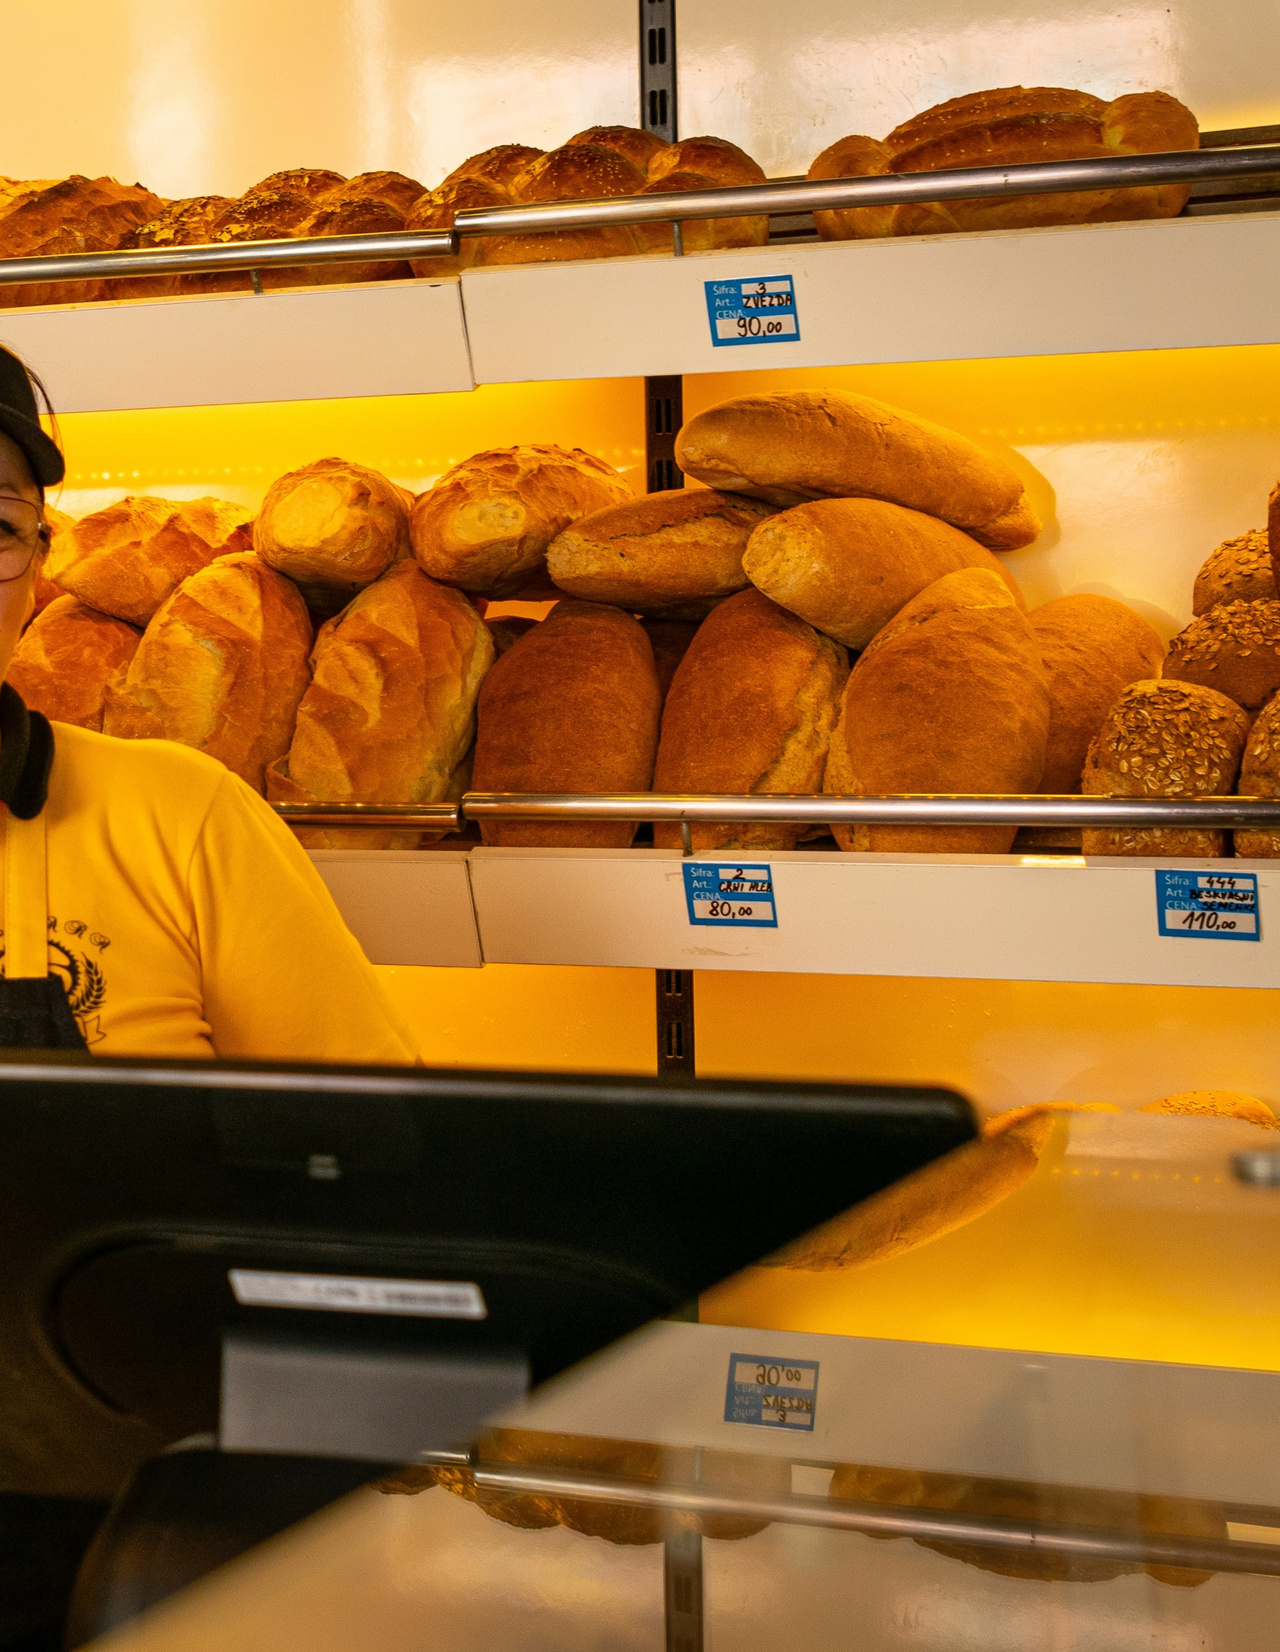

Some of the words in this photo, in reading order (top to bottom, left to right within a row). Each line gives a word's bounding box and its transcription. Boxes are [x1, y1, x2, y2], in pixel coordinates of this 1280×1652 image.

[712, 285, 738, 296] Šifra:
[755, 282, 767, 295] 3
[743, 294, 792, 309] ZVEZDA
[716, 309, 747, 319] CENA:
[737, 316, 782, 337] 90,00
[690, 867, 715, 877] Šifra:
[732, 868, 746, 881] 2
[692, 880, 712, 889] Art.:
[718, 881, 745, 893] CRNI
[1165, 874, 1192, 885] Šifra:
[1206, 875, 1236, 889] 444
[693, 891, 724, 901] CENA:
[709, 901, 752, 919] 80,00
[1182, 911, 1236, 931] 110,00
